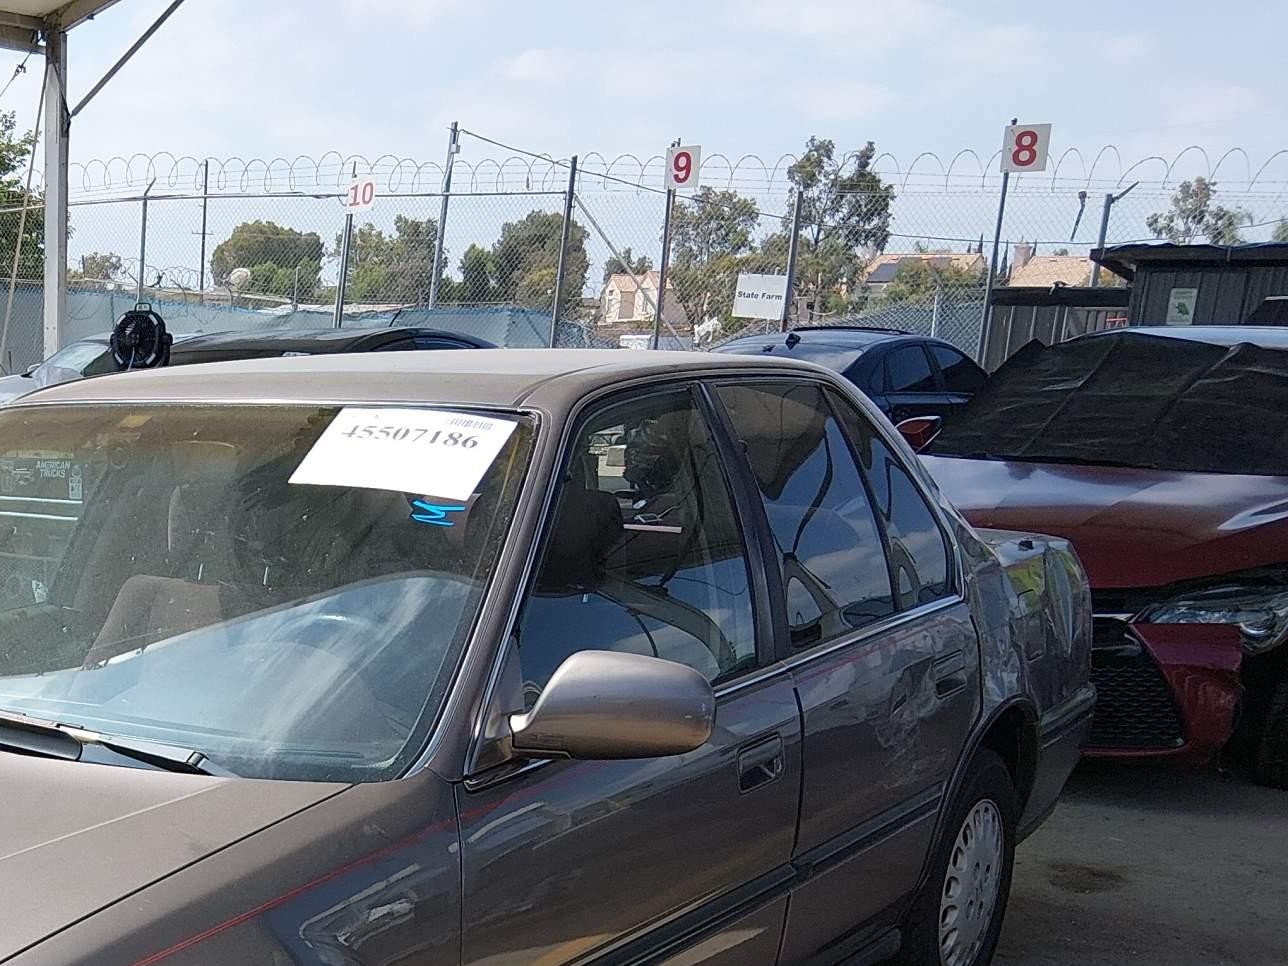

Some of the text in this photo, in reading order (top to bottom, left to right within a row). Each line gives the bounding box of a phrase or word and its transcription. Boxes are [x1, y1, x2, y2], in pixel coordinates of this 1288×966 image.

[1013, 131, 1038, 166] 8
[674, 152, 691, 183] 9
[349, 182, 374, 206] 10
[737, 291, 759, 299] State
[342, 425, 479, 448] 45507186
[36, 460, 71, 470] AMERICAN
[40, 469, 66, 478] TRUCKS
